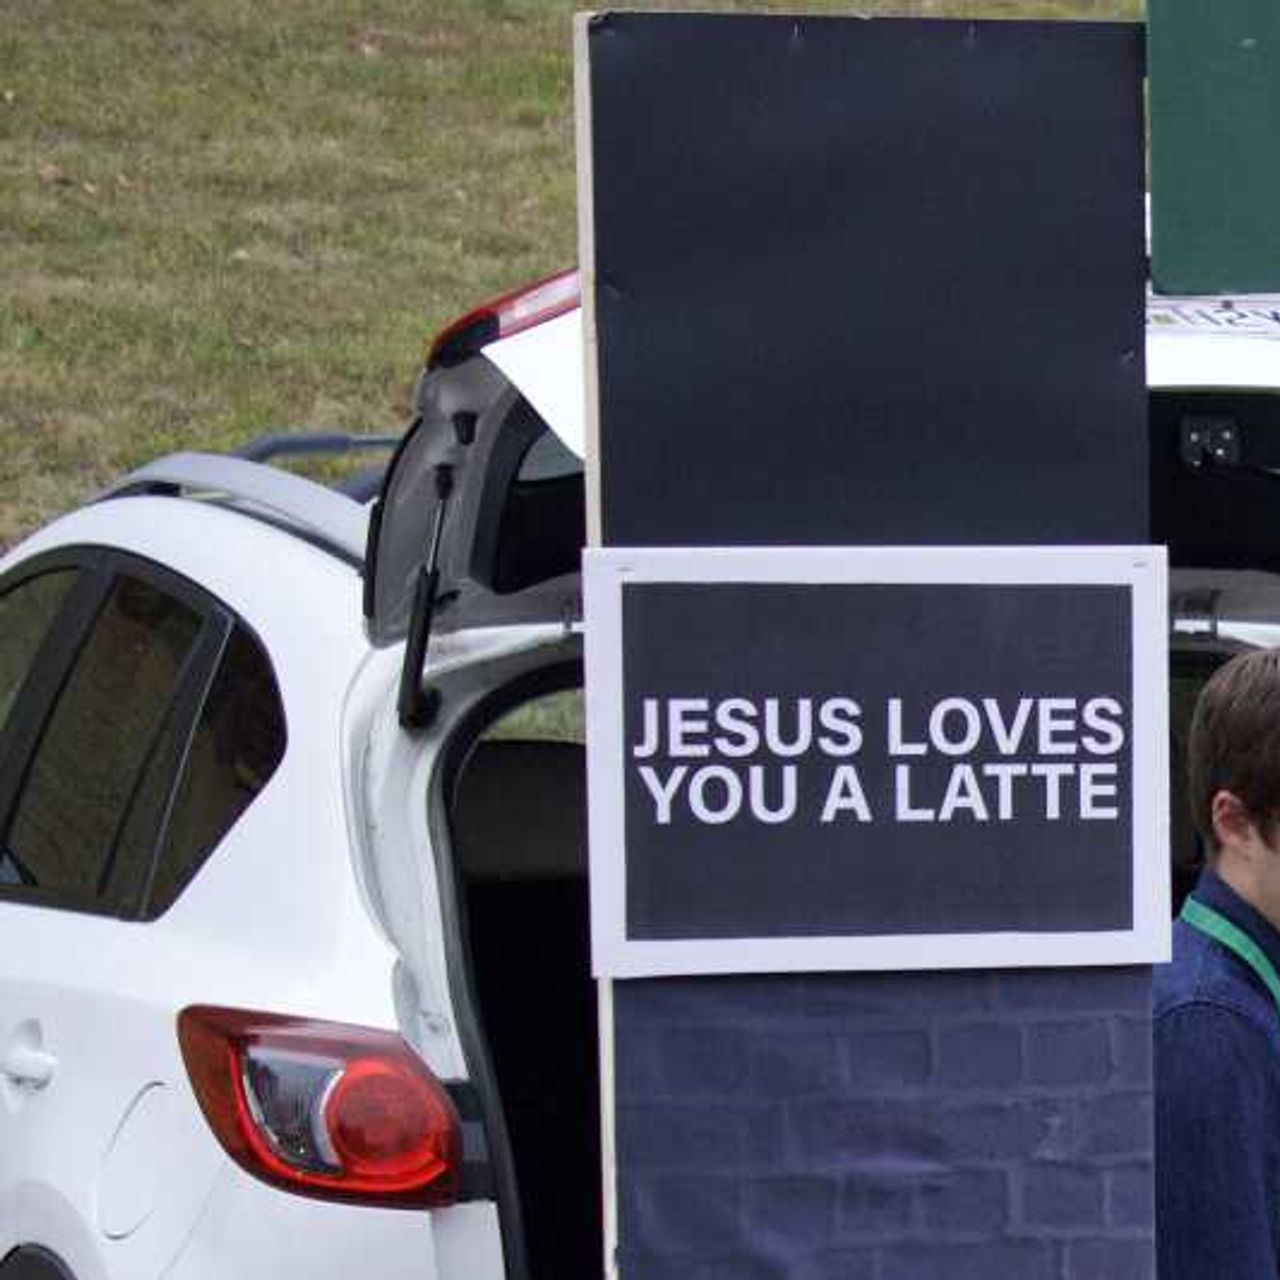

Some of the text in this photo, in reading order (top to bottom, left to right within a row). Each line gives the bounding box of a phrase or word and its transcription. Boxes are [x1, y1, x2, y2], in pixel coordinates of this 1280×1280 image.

[634, 698, 1125, 757] JESUS LOVES
[639, 764, 1118, 823] YOU A LATTE
